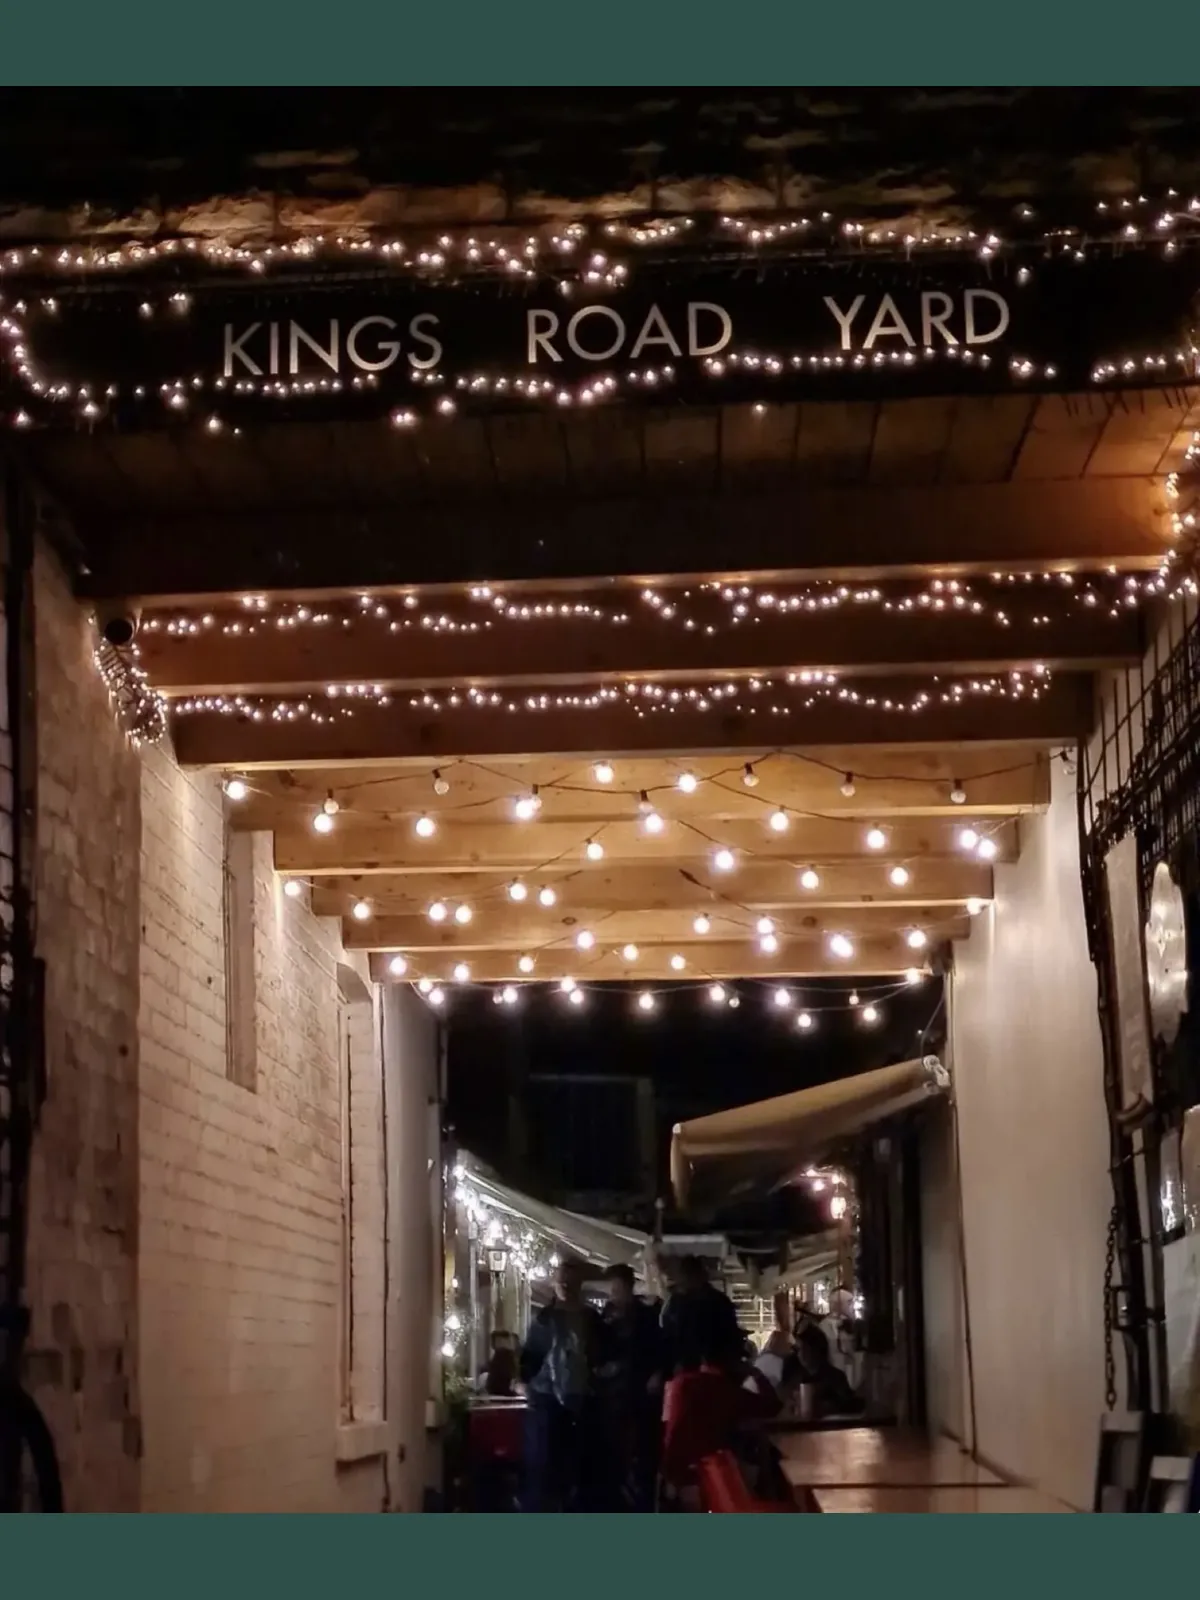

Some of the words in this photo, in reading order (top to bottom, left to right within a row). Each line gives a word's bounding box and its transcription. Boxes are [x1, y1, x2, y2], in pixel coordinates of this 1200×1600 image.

[223, 313, 443, 377] KINGS
[526, 303, 733, 363] ROAD
[823, 288, 1010, 350] YARD
